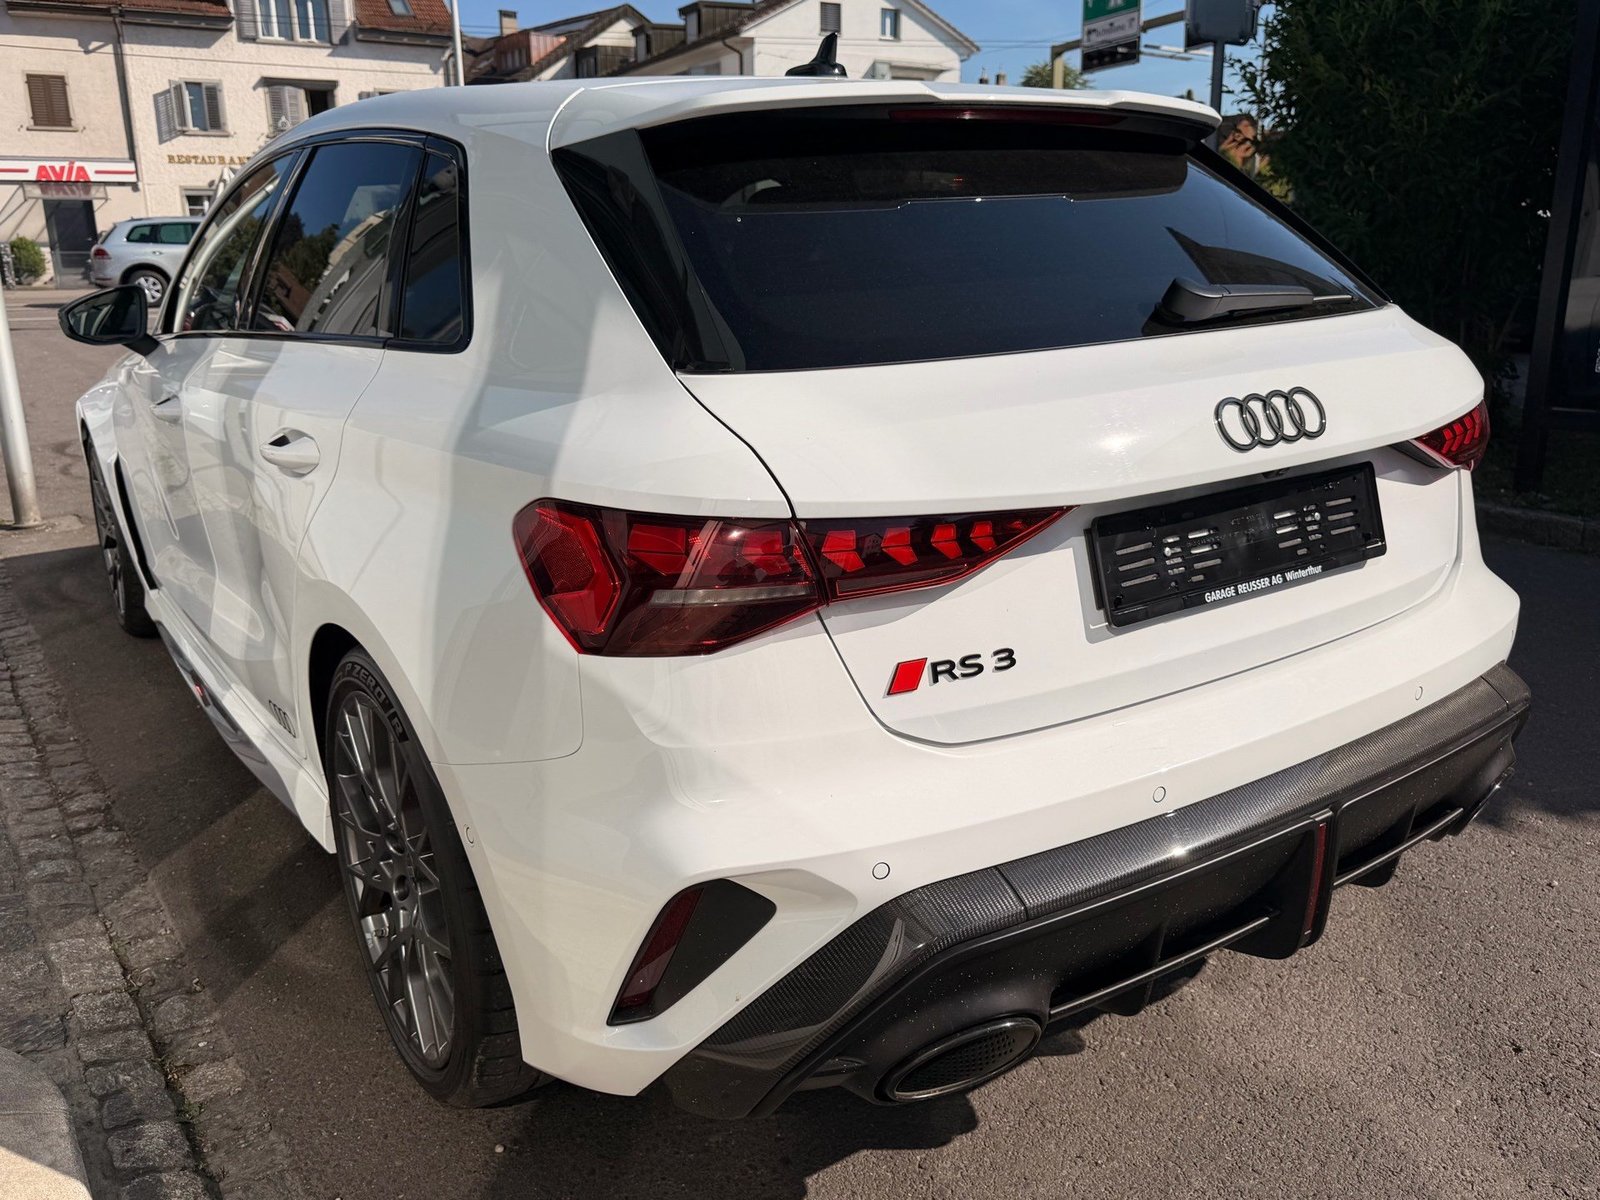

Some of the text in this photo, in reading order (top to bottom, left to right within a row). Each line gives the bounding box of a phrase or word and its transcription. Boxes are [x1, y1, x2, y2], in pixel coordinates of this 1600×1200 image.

[35, 160, 91, 181] AVIA
[1204, 564, 1322, 603] GARAGE REUSSER AG Winterthur
[351, 663, 387, 703] ZERO
[930, 647, 1017, 684] RS 3
